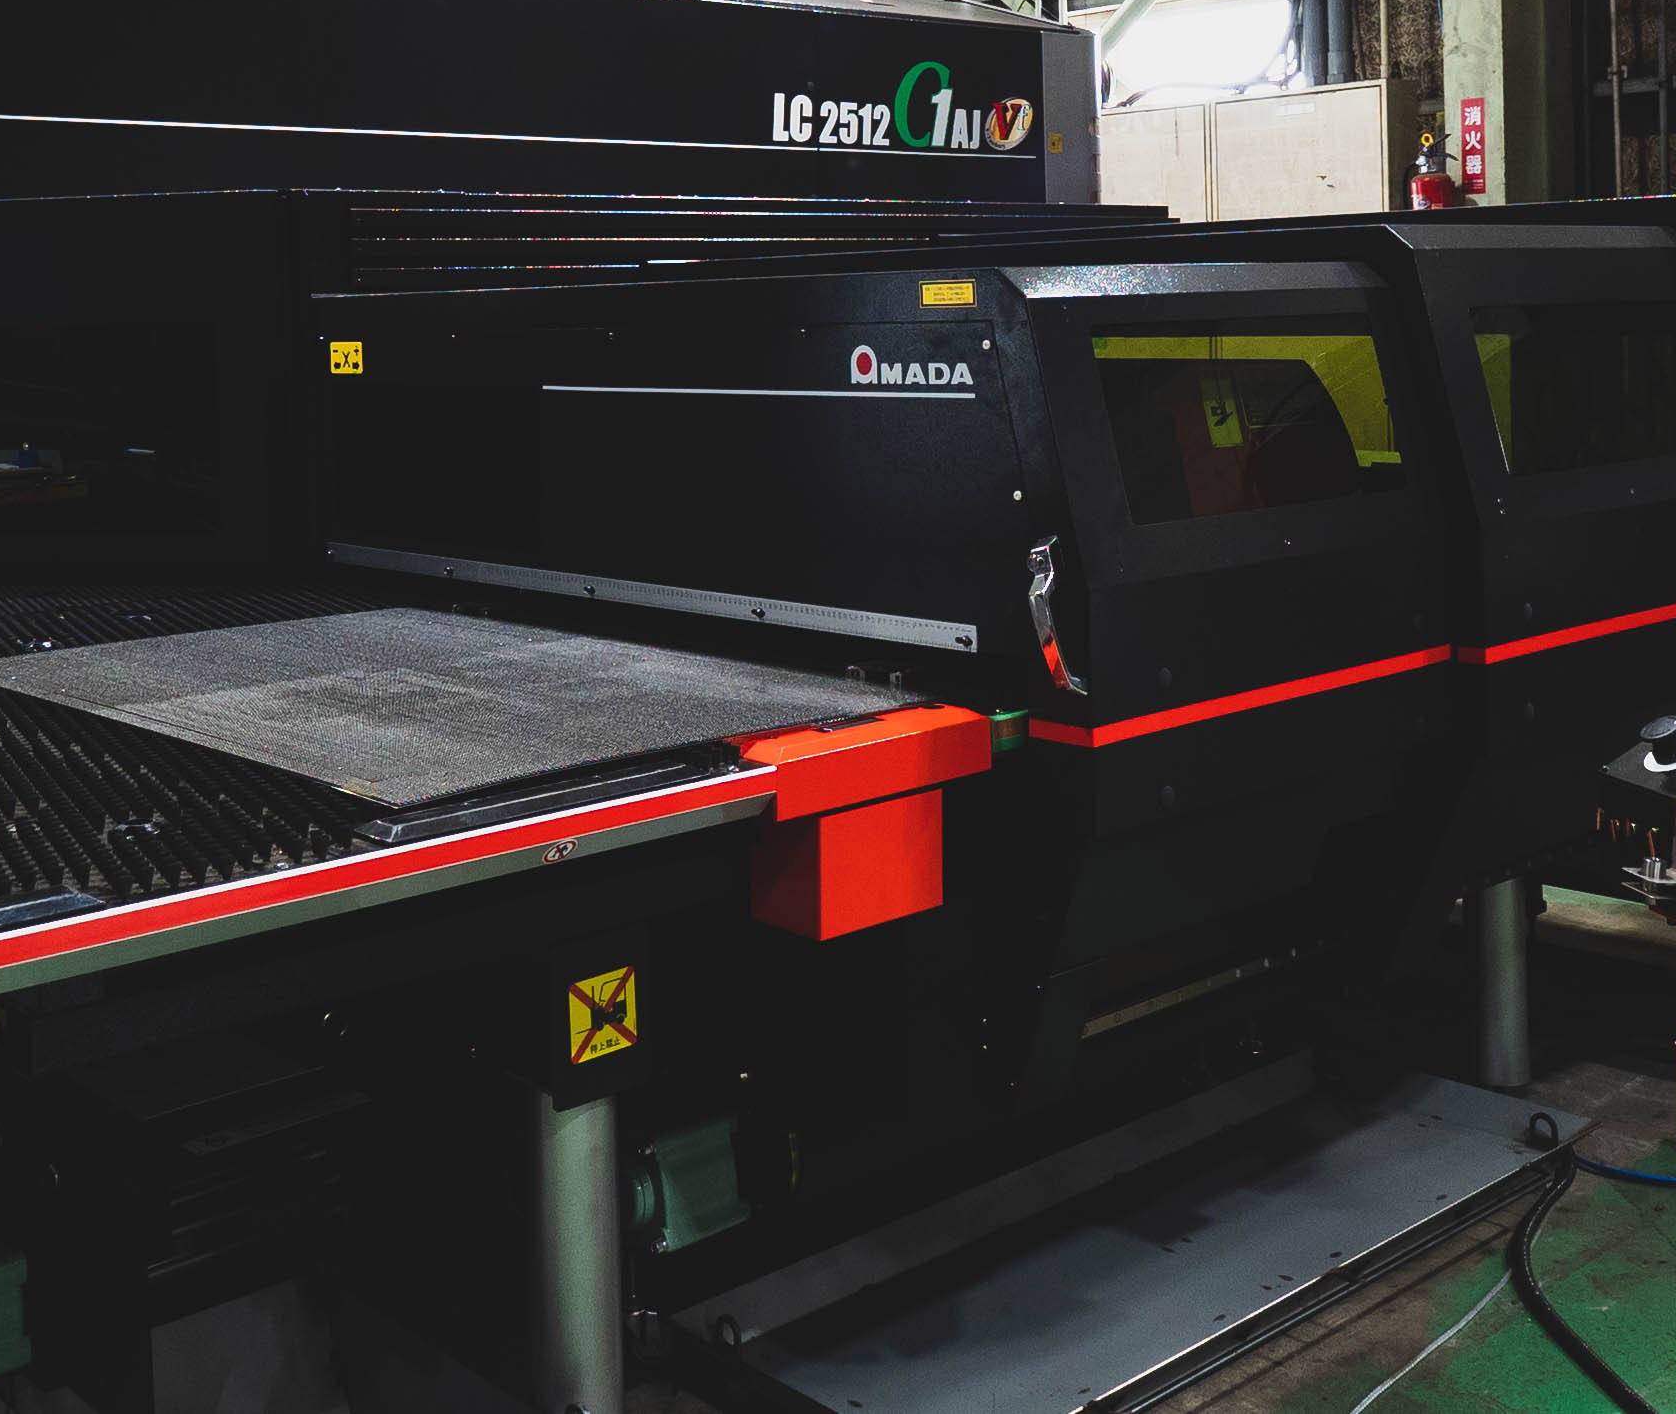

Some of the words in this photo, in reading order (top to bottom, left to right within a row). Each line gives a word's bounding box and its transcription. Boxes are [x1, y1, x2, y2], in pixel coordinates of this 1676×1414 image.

[773, 92, 813, 142] LC
[819, 100, 891, 146] 2512
[1464, 105, 1482, 175] 消火器
[341, 351, 351, 369] X
[850, 344, 974, 385] AMADA
